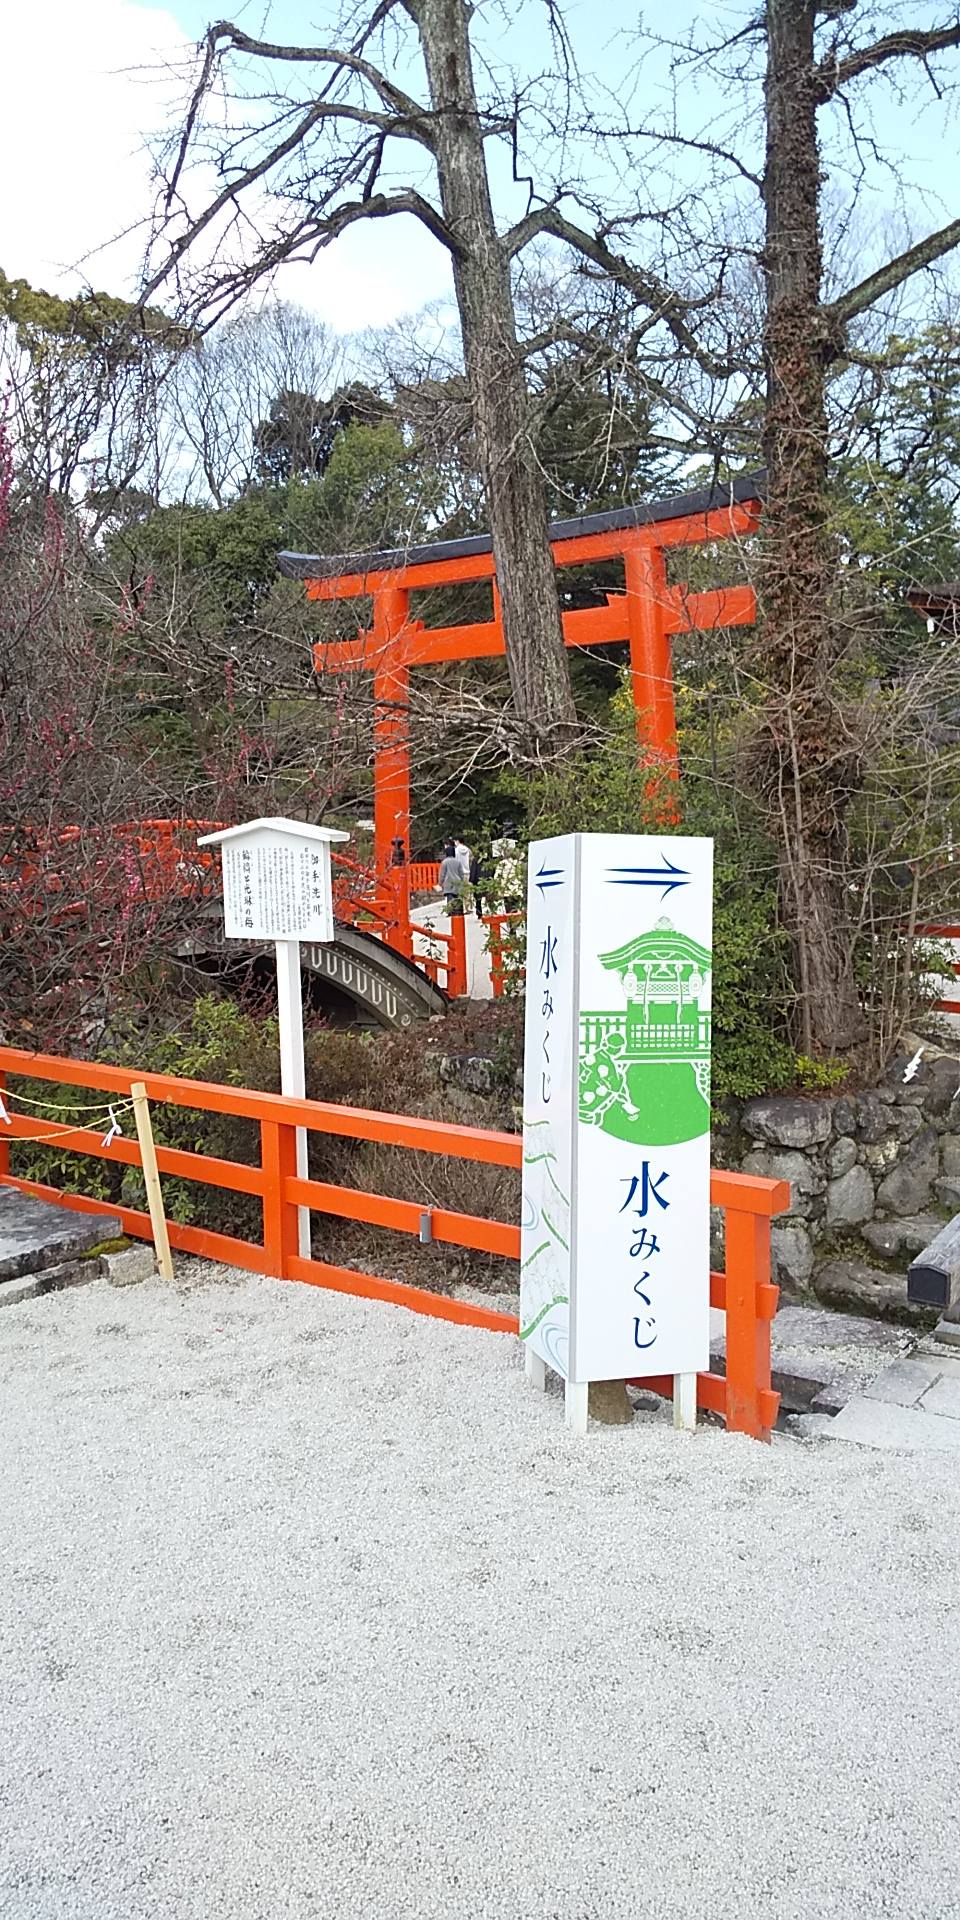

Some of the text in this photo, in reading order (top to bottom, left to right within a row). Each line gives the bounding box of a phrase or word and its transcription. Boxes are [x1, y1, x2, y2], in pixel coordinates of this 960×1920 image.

[539, 924, 558, 1105] 水みくじ
[618, 1160, 671, 1348] 水みくじ
